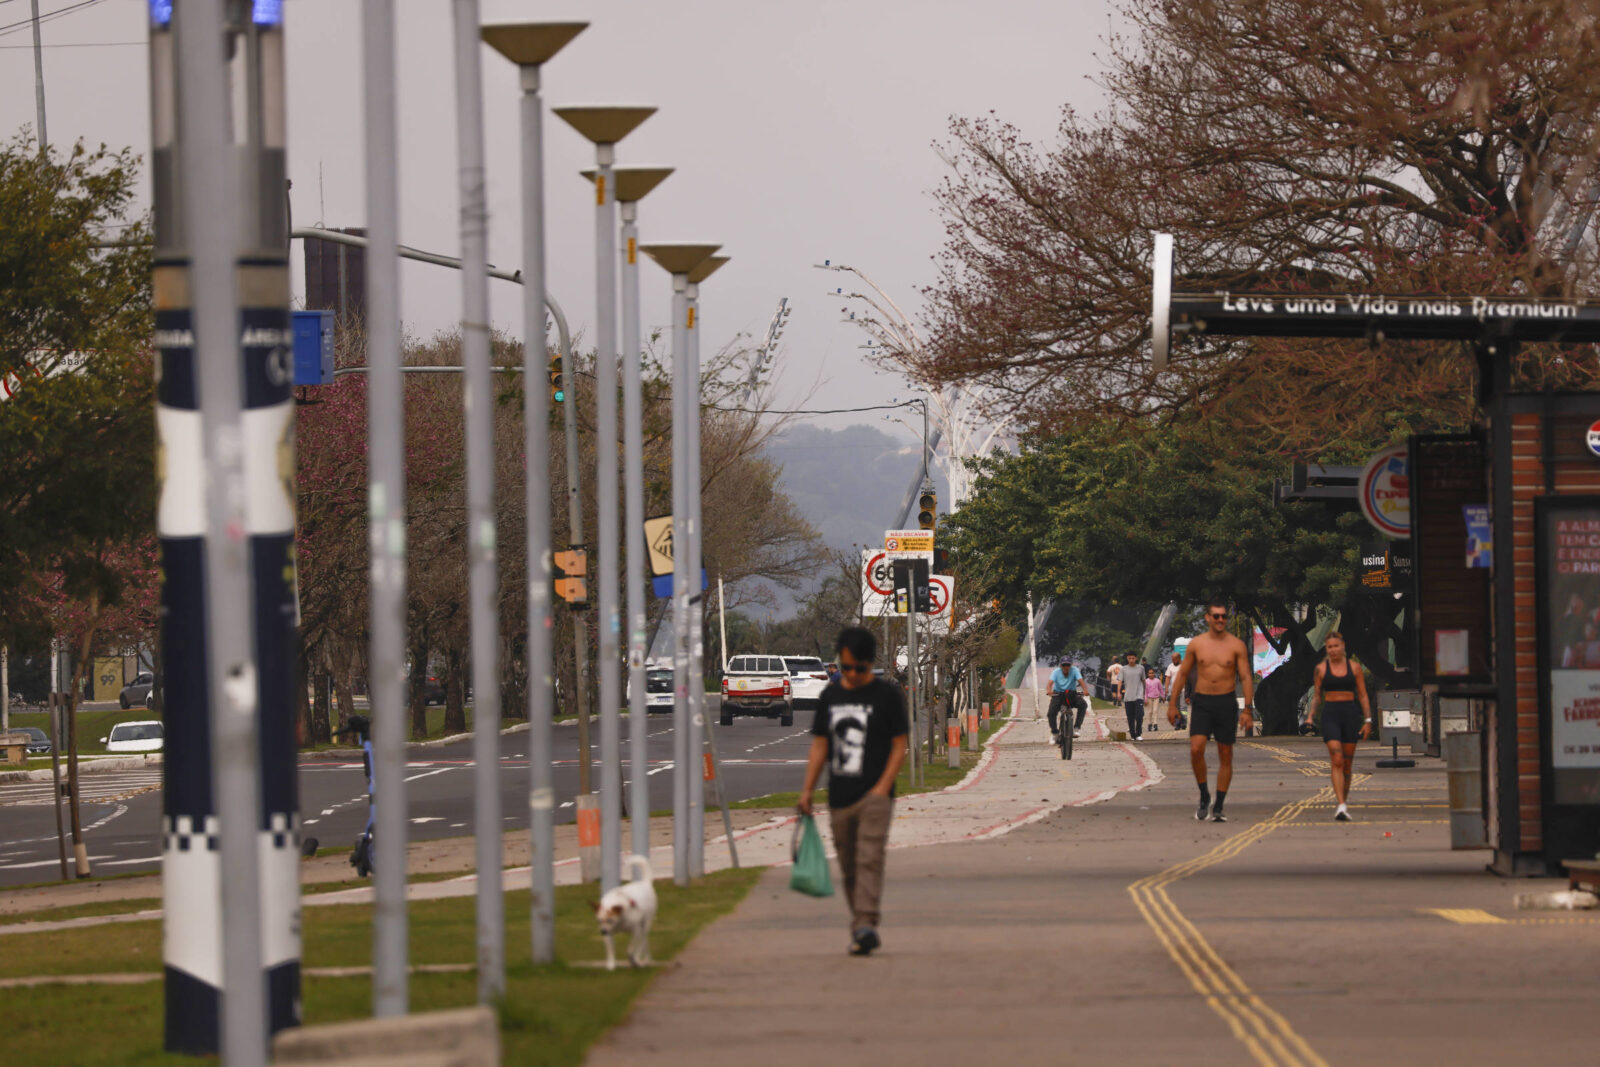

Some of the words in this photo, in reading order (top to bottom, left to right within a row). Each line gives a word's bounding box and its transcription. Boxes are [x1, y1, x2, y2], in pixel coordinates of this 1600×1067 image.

[1285, 297, 1336, 313] uma
[1346, 294, 1399, 315] Vida
[1408, 295, 1462, 317] mais
[1362, 554, 1385, 566] usina
[875, 564, 895, 581] 60
[100, 674, 116, 686] 99
